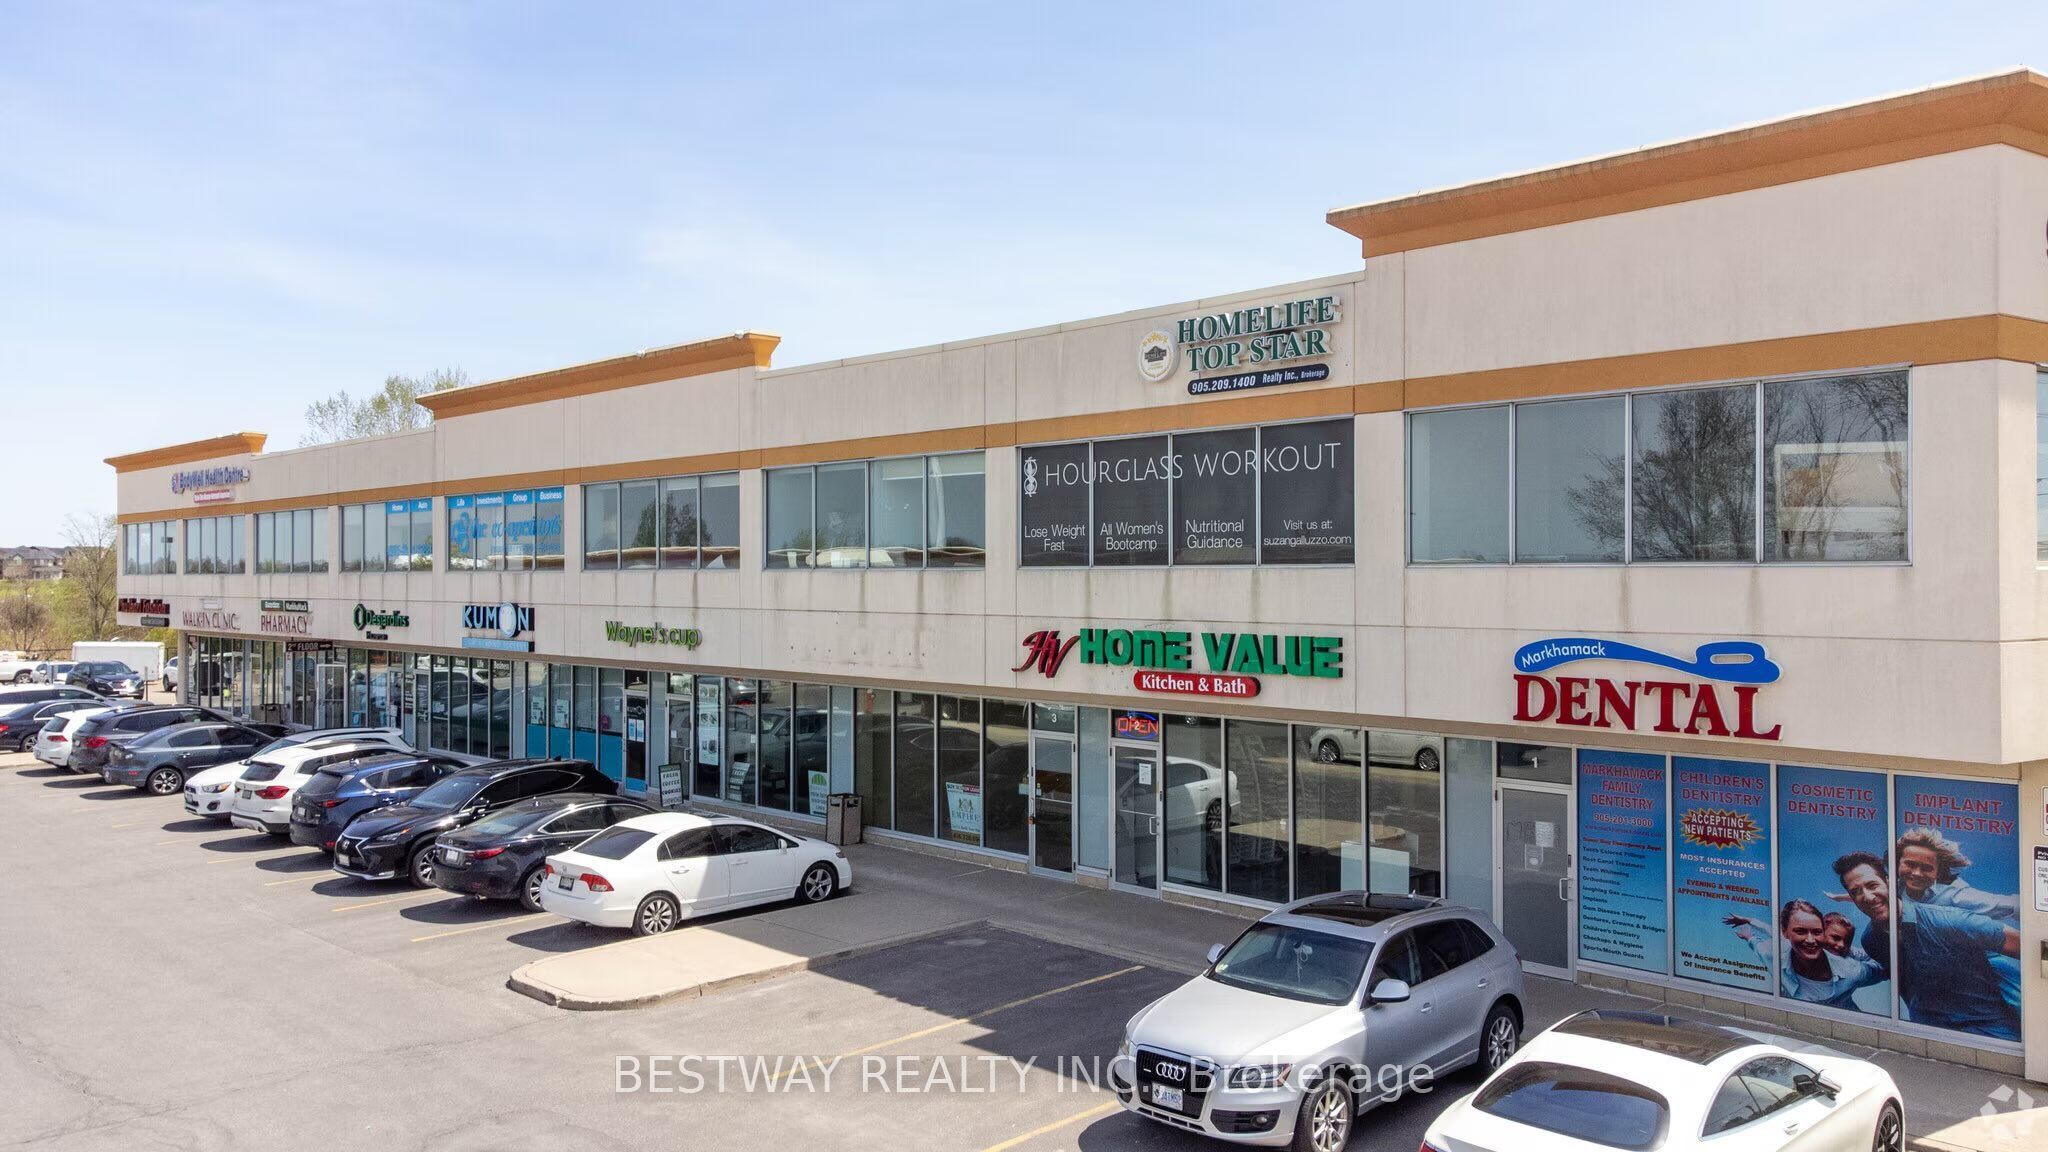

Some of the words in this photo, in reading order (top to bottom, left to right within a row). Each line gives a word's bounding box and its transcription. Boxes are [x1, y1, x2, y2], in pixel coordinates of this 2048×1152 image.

[1177, 296, 1335, 344] HOMELIFE
[1186, 342, 1242, 372] TOP
[1250, 329, 1327, 363] STAR
[1192, 376, 1256, 394] 905.209.1400
[1262, 373, 1283, 384] Realty
[1301, 369, 1325, 379] Brokerage
[1046, 454, 1183, 486] HOURGLASS
[1194, 443, 1341, 477] WORKOUT
[513, 493, 527, 503] Group
[540, 491, 562, 500] Business
[1024, 525, 1048, 538] Lose
[1051, 524, 1086, 540] Weight
[1100, 522, 1113, 536] All
[1116, 521, 1164, 535] Women's
[1186, 519, 1244, 534] Nutritional
[1284, 519, 1306, 530] Visit
[1308, 521, 1317, 530] us
[1320, 519, 1333, 530] at:
[1044, 538, 1065, 551] Fast
[1106, 537, 1157, 552] Bootcamp
[1186, 534, 1243, 549] Guidance
[1264, 534, 1352, 548] suzangalluzzo.com
[261, 615, 309, 634] PHARMACY
[366, 610, 409, 629] Desjardins
[462, 602, 535, 638] KUMON
[605, 620, 667, 648] Wayne's
[669, 628, 703, 651] cup
[1080, 628, 1192, 669] HOME
[1201, 632, 1343, 678] VALUE
[1521, 641, 1606, 668] Markhamack
[1142, 674, 1193, 692] Kitchen
[1198, 678, 1209, 692] &
[1214, 678, 1246, 694] Bath
[1513, 674, 1783, 741] DENTAL
[1051, 713, 1057, 722] 3
[1117, 717, 1158, 734] OPEN
[1532, 757, 1538, 768] 1
[1582, 764, 1664, 780] MARKHAMACK
[1603, 780, 1641, 794] FAMILY
[1680, 771, 1764, 790] CHILDREN'S
[1682, 788, 1761, 806] DENTISTRY
[1791, 783, 1873, 801] COSMETIC
[1591, 794, 1653, 810] DENTISTRY
[1788, 800, 1877, 820] DENTISTRY
[1914, 793, 2002, 814] IMPLANT
[1692, 814, 1744, 828] ACCEPTING
[1904, 811, 2015, 836] DENTISTRY
[1684, 824, 1704, 835] NEW
[1707, 826, 1751, 840] PATIENTS
[1680, 853, 1704, 862] MOST
[1707, 857, 1766, 870] INSURANCES
[1699, 866, 1745, 878] ACCEPTED
[1687, 879, 1716, 889] EVENING
[1725, 884, 1760, 895] WEEKEND
[1678, 888, 1729, 900] APPOINTMENTS
[1731, 895, 1770, 906] AVAILABLE
[1598, 907, 1620, 915] Disease
[1622, 911, 1646, 920] Therapy
[1583, 924, 1611, 934] Children's
[1613, 930, 1640, 939] Dentistry
[1612, 920, 1634, 928] Crowns
[1642, 924, 1665, 933] Bridges
[1583, 934, 1611, 944] Checkups
[1619, 940, 1643, 949] Hygiene
[1623, 949, 1644, 959] Guards
[1694, 953, 1720, 964] Accept
[1723, 958, 1768, 972] Assignment
[1695, 962, 1731, 974] Insurance
[1734, 969, 1766, 980] Benefits
